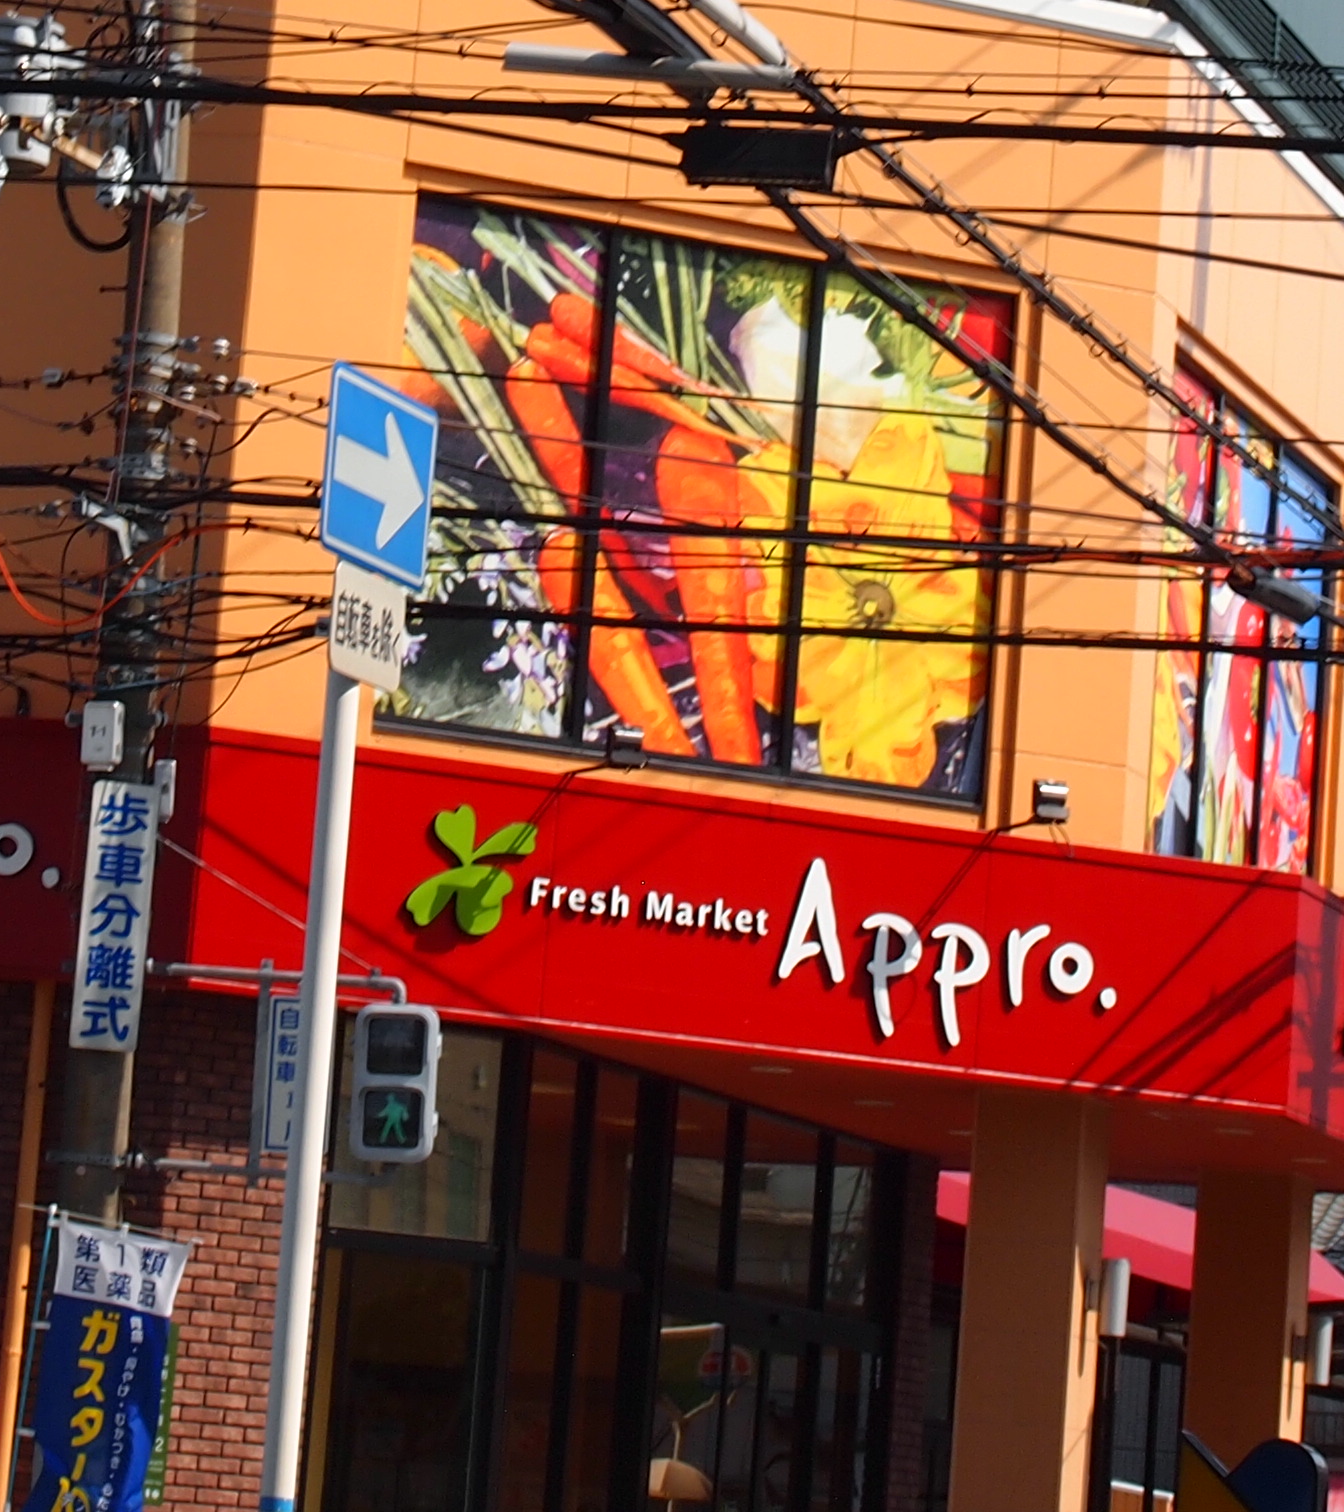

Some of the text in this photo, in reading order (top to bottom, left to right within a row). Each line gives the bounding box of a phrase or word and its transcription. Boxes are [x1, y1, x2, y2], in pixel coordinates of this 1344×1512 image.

[335, 589, 400, 668] 自転車を除く
[80, 792, 143, 1042] 歩車分離式
[528, 876, 770, 938] Fresh Market
[778, 857, 1118, 1048] Appro.
[71, 1264, 158, 1310] 医薬品
[74, 1233, 169, 1279] 第1類
